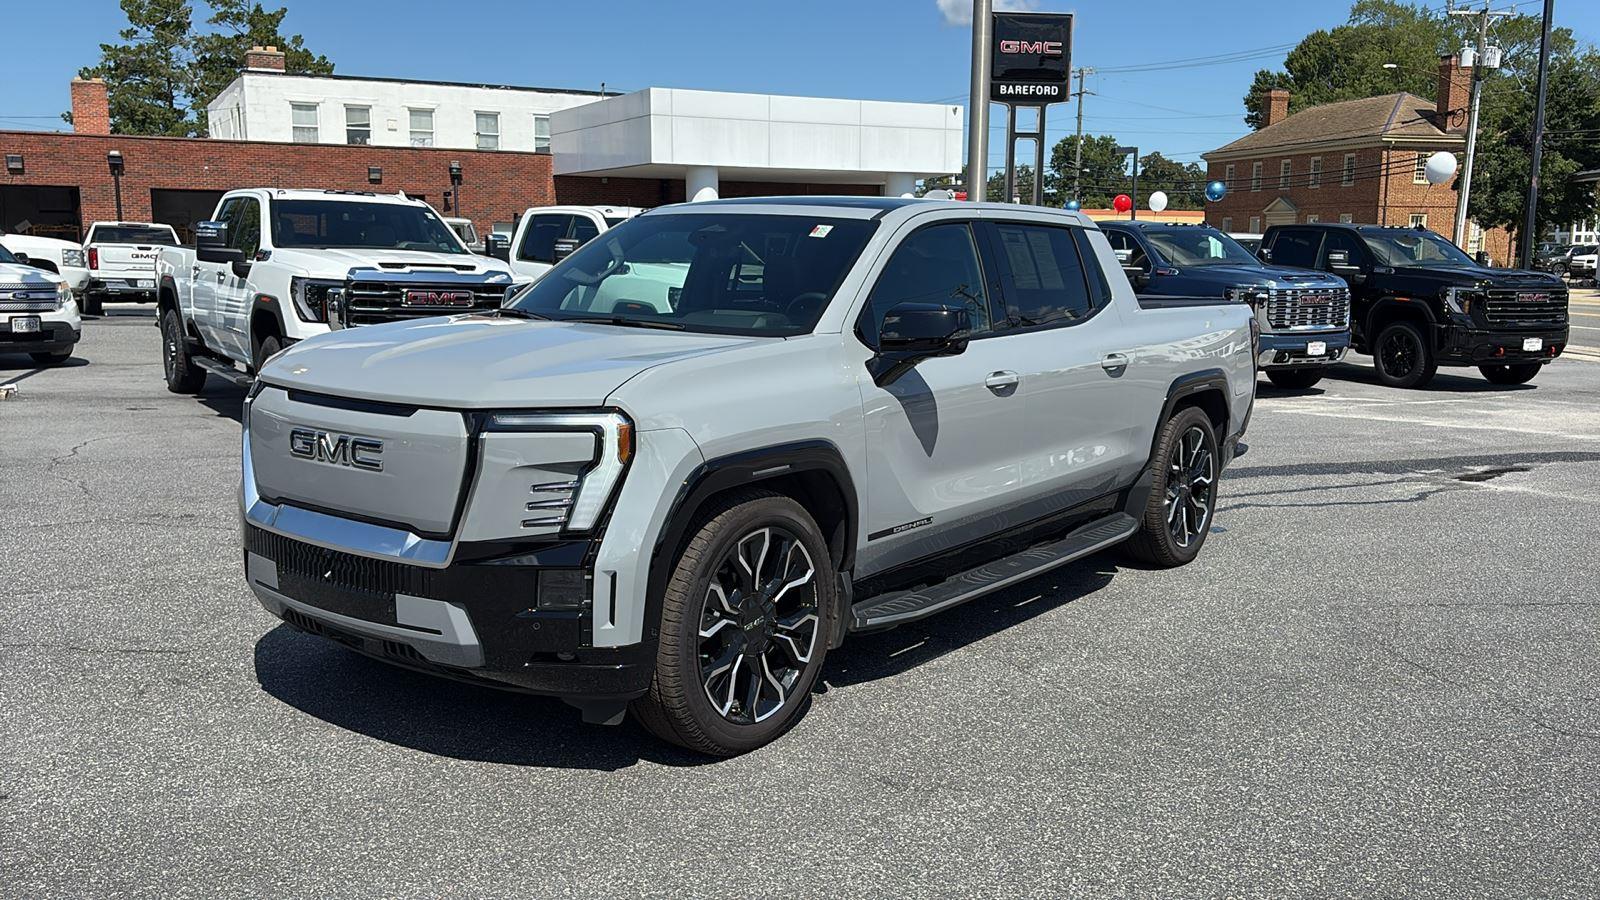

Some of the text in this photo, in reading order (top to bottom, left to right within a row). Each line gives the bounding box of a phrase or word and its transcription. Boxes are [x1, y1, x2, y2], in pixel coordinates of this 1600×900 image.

[1000, 40, 1062, 55] GMC
[1000, 85, 1059, 96] BAREFORD
[407, 291, 469, 305] GMC
[290, 427, 384, 473] GMC
[893, 518, 933, 533] DENALI
